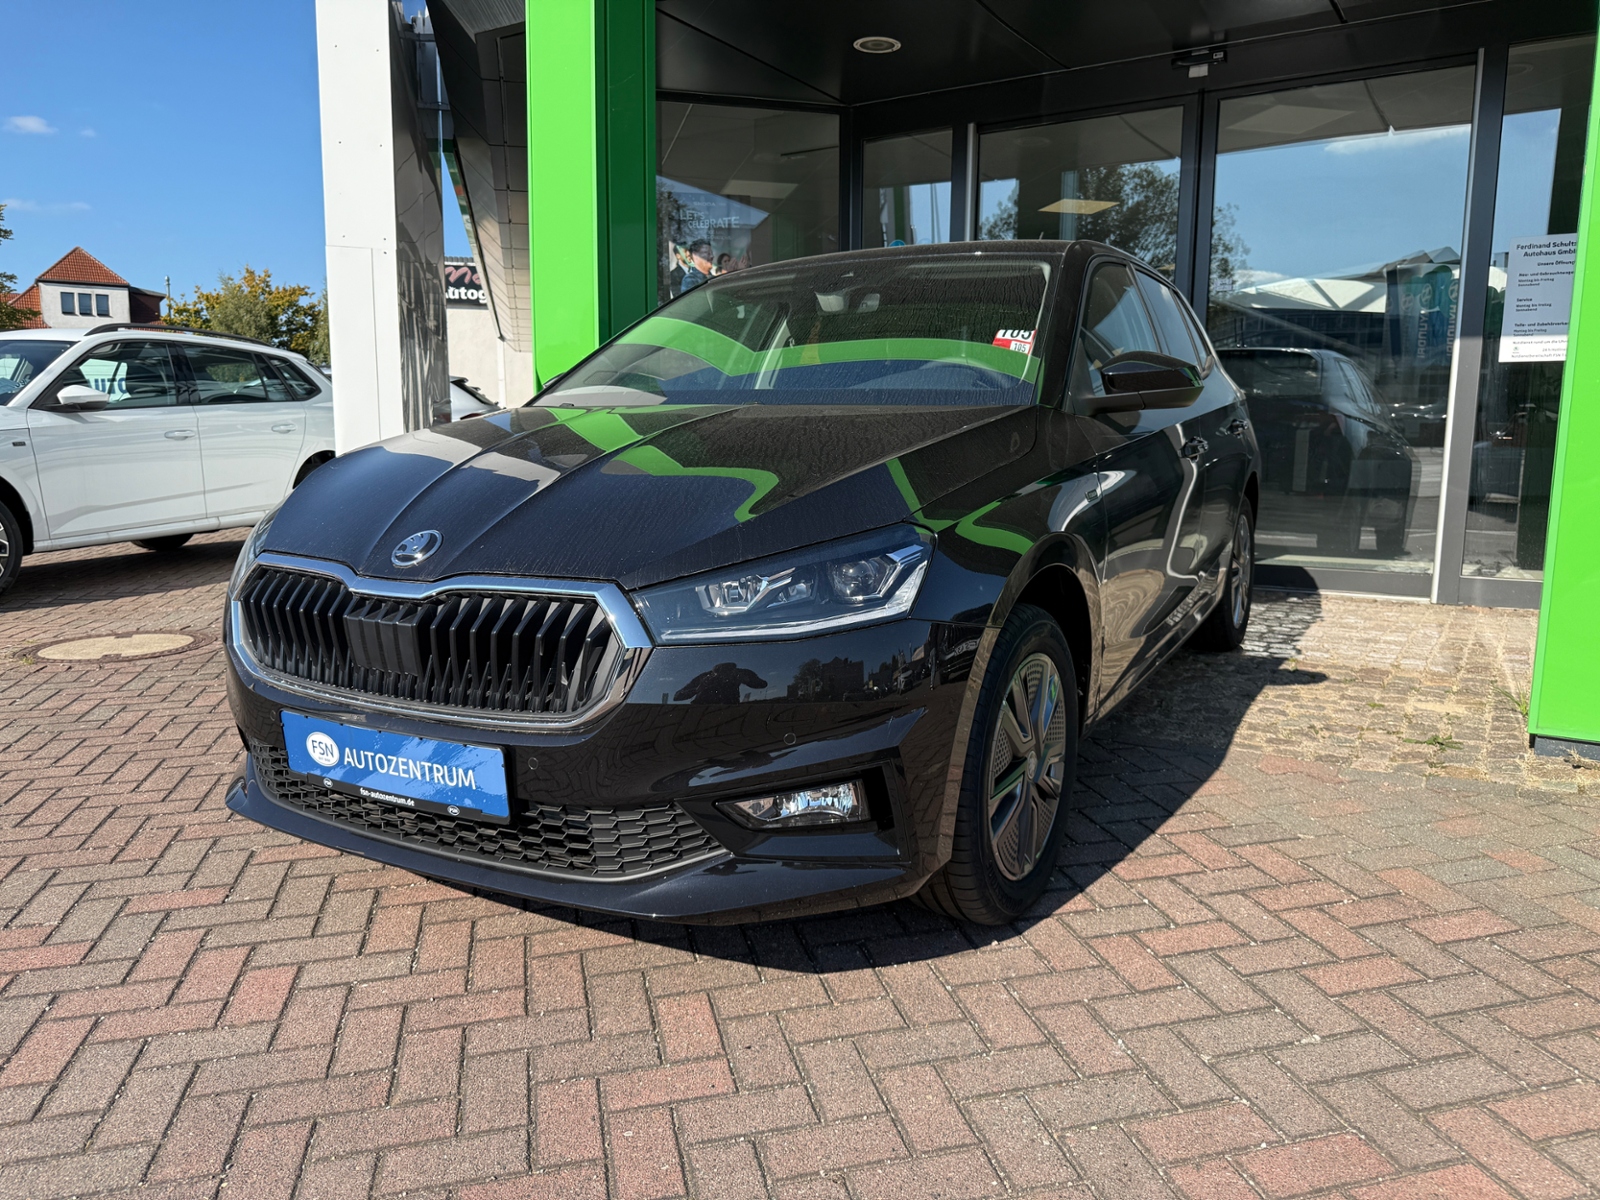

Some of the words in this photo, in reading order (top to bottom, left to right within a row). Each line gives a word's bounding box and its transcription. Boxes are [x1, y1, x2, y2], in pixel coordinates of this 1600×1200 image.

[680, 209, 705, 220] LET'S
[688, 216, 740, 229] CELEBRATE
[1516, 242, 1551, 250] Ferdinand
[1523, 249, 1556, 257] Autohaus
[1014, 343, 1027, 352] 105
[311, 739, 335, 758] FSN
[344, 747, 477, 790] AUTOZENTRUM
[359, 787, 415, 807] fsn-autozentrum.de
